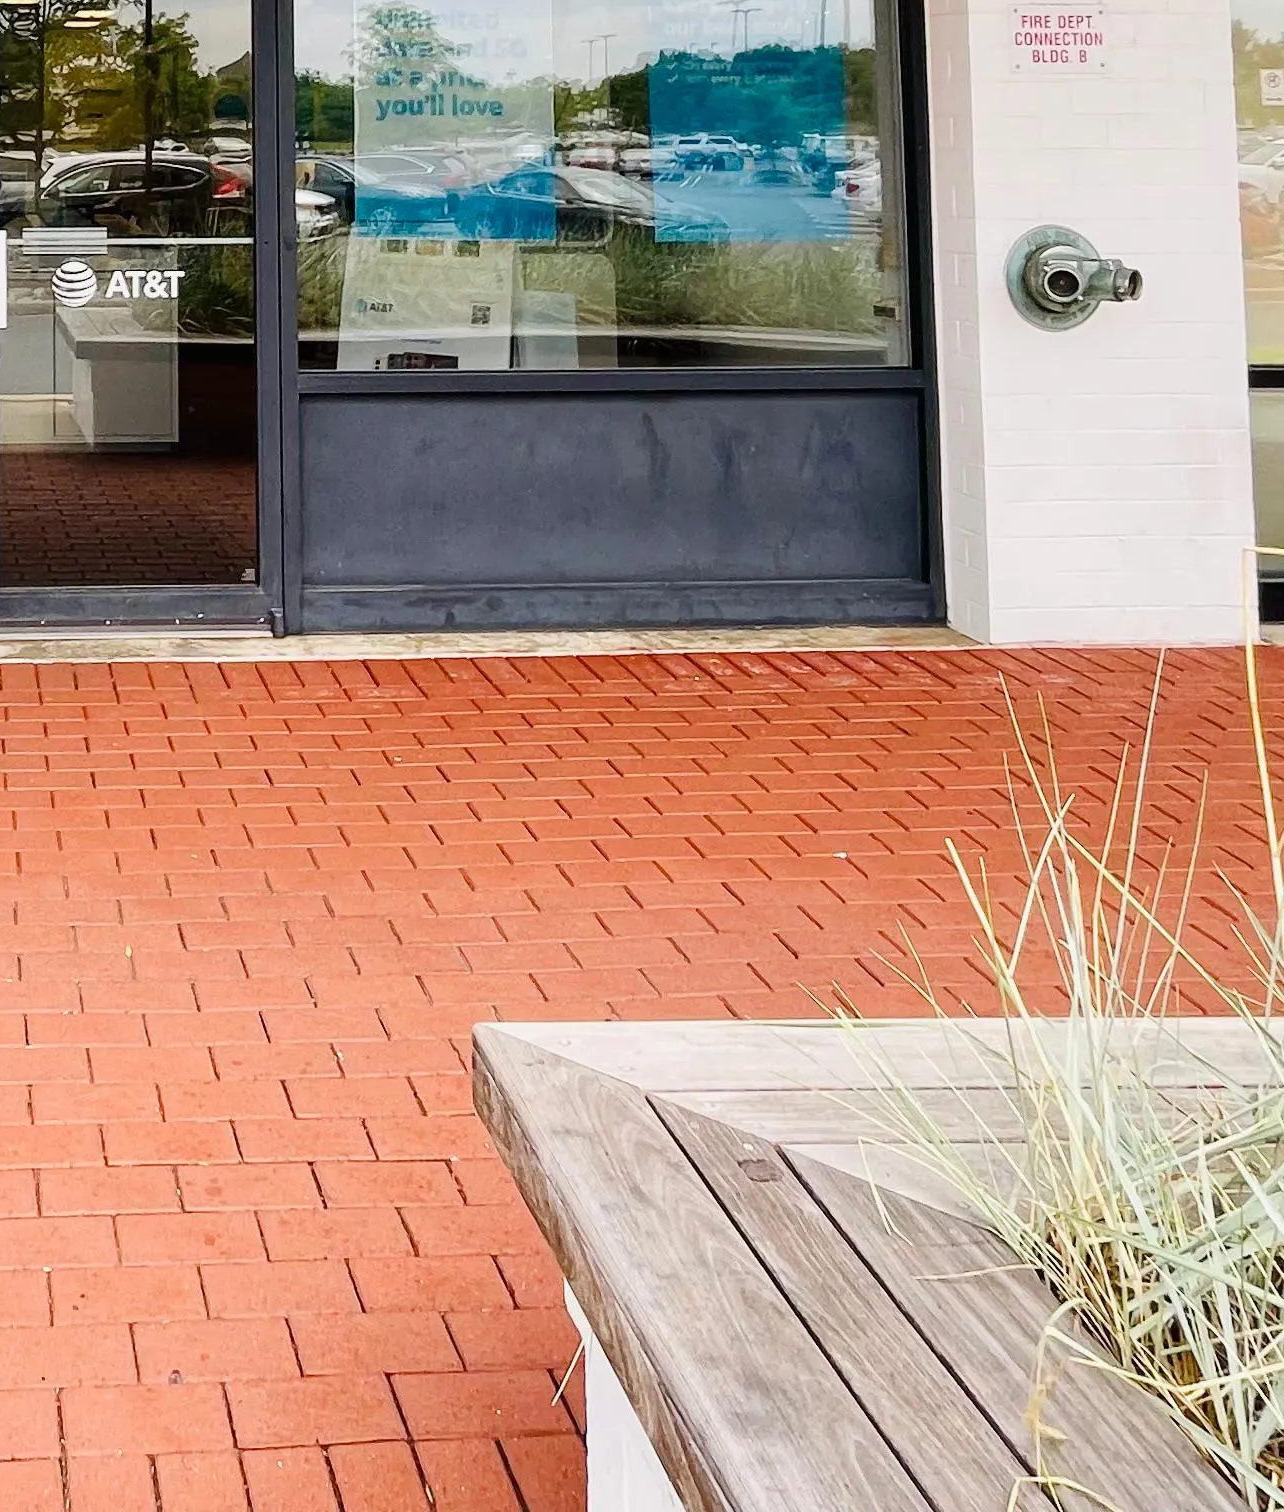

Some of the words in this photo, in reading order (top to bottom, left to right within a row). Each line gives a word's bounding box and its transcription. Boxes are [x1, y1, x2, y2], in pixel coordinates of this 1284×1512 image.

[1020, 15, 1051, 29] FIRE
[1014, 32, 1103, 46] CONNECTION
[1079, 50, 1087, 64] B
[376, 95, 445, 121] you'll
[452, 95, 505, 117] love
[104, 270, 186, 300] AT&T
[369, 302, 395, 313] AT&T
